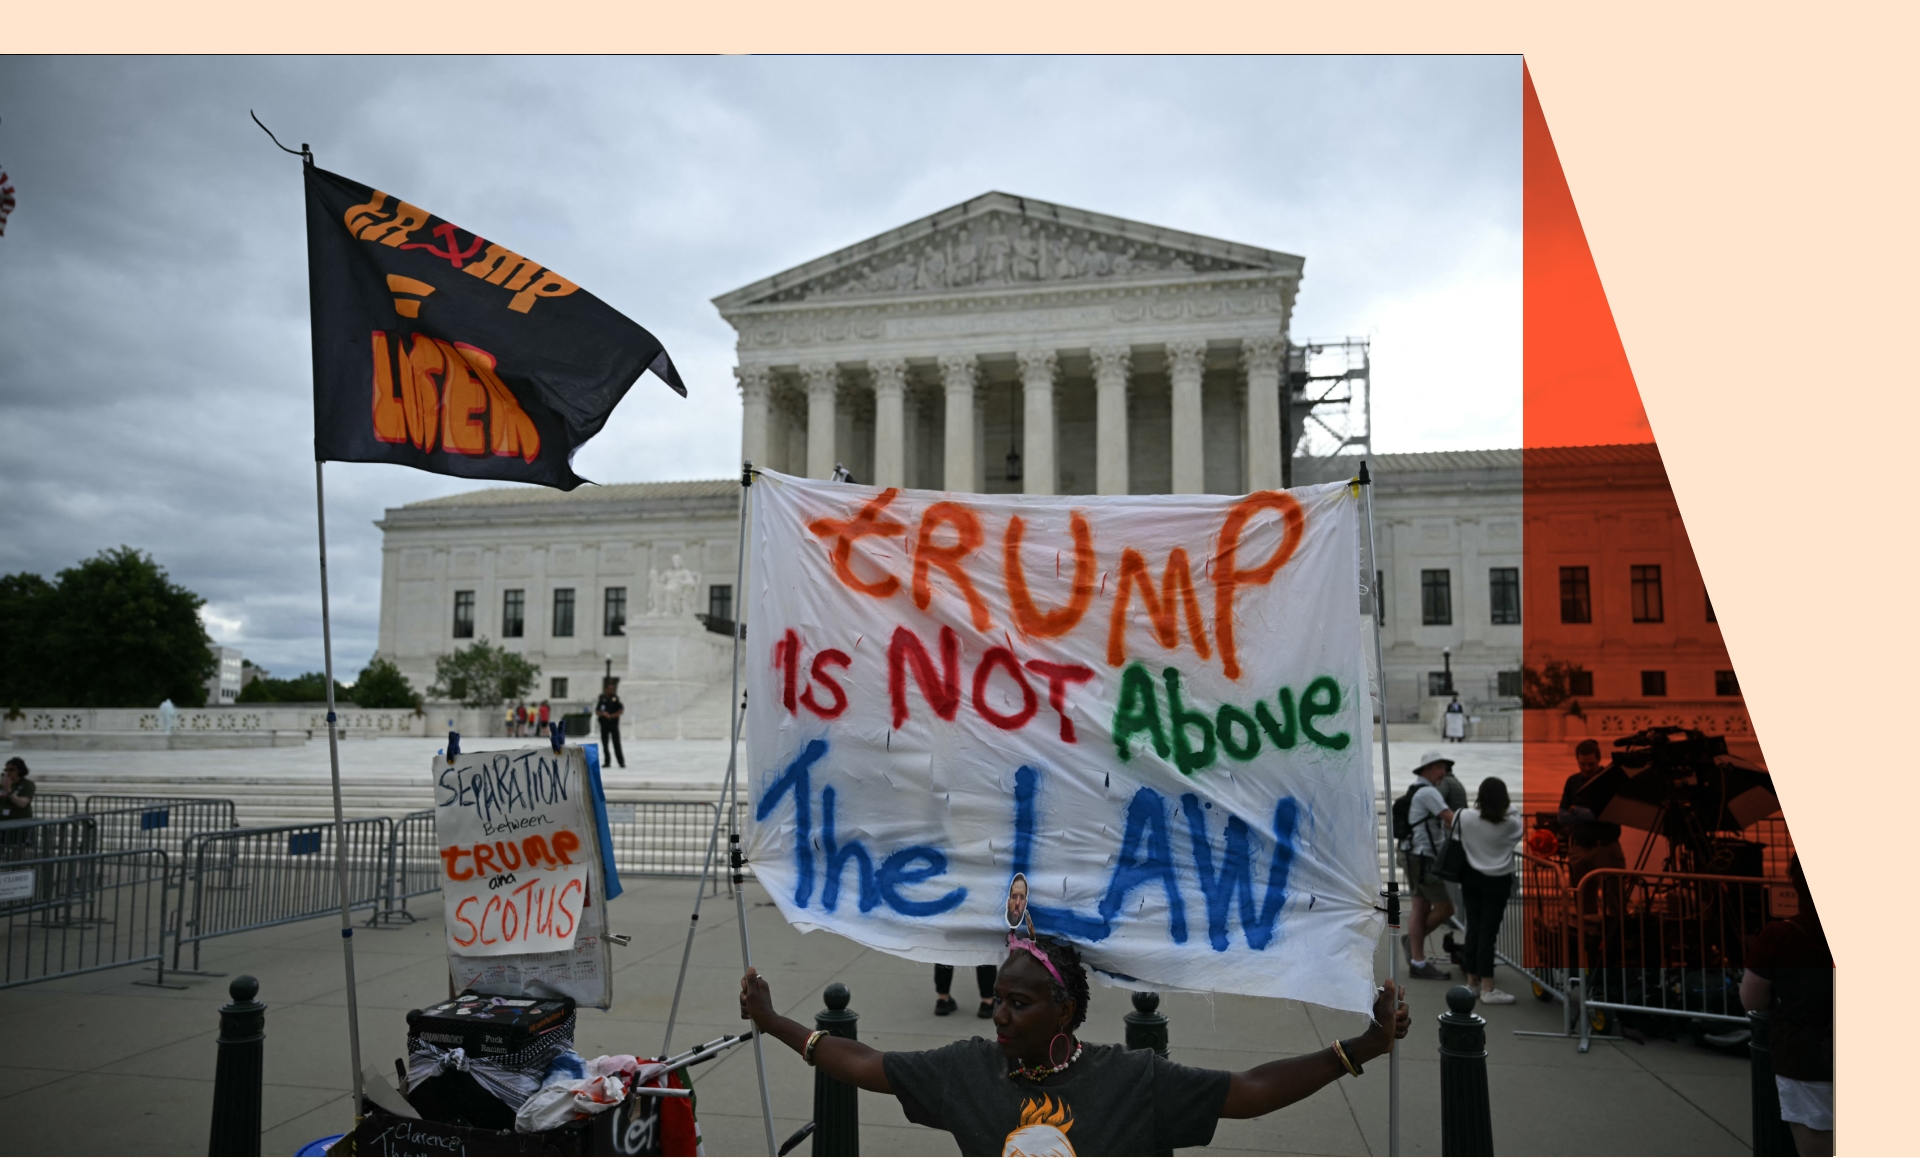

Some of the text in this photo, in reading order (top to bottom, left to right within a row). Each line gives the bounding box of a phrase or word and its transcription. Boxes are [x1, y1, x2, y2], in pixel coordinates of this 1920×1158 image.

[887, 626, 1094, 744] NOT
[1112, 662, 1351, 776] Above
[438, 751, 570, 822] SEPARATION
[483, 814, 555, 837] Between
[756, 738, 1300, 953] The LAW
[3, 875, 29, 883] CLOSED
[488, 873, 517, 890] and
[1778, 891, 1797, 899] ARE
[452, 878, 582, 947] SCOTUS
[419, 1031, 464, 1045] SOUNDBOKS
[485, 1034, 504, 1044] Fuck
[480, 1044, 508, 1054] Racism
[394, 1122, 461, 1151] Clarence
